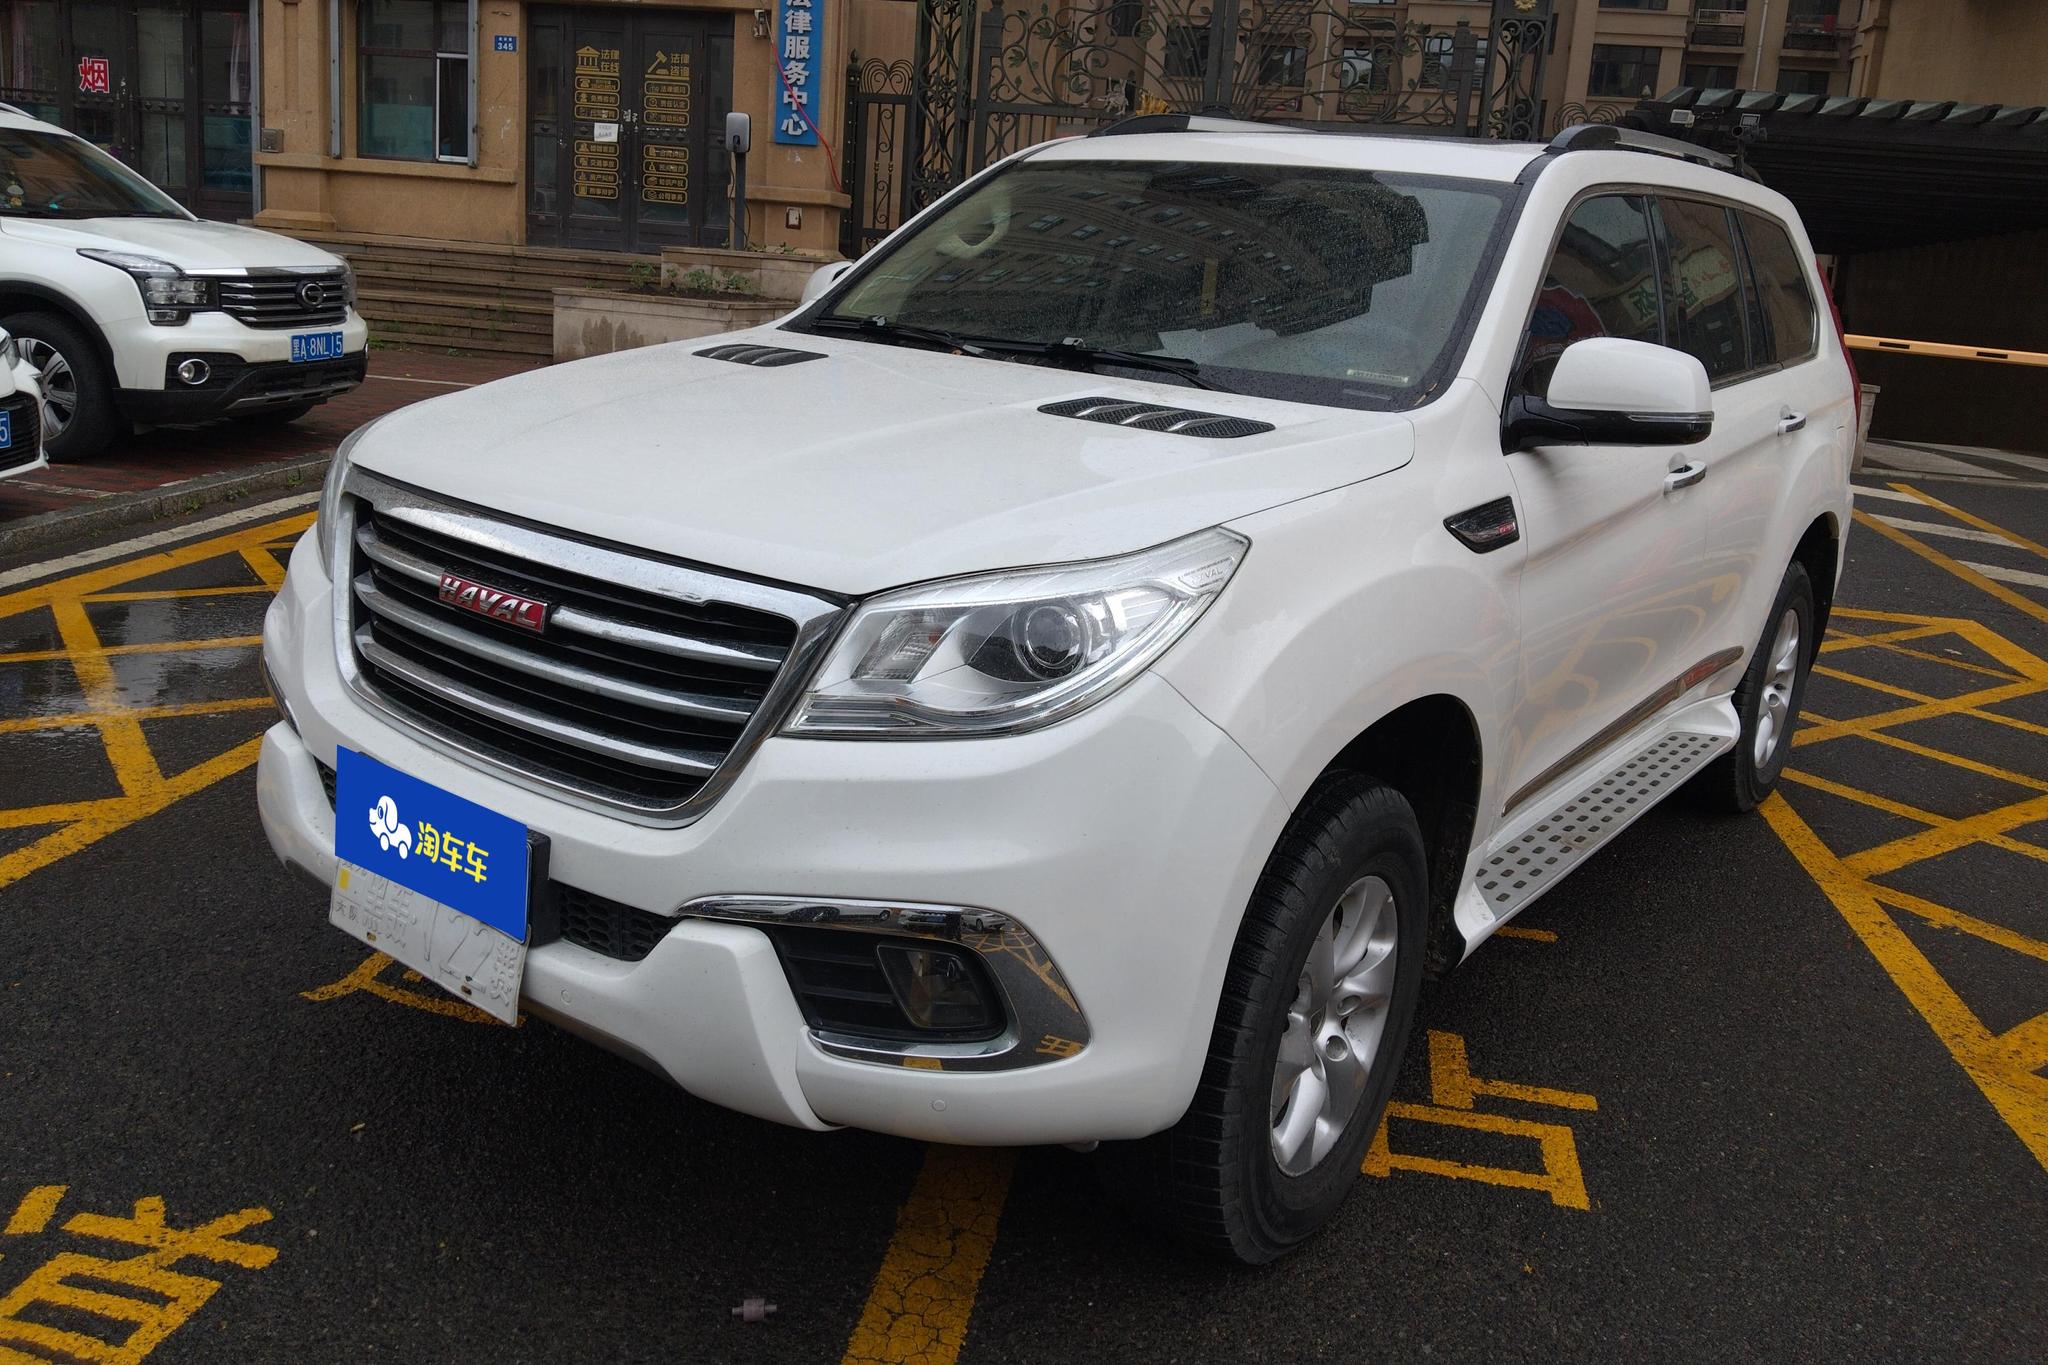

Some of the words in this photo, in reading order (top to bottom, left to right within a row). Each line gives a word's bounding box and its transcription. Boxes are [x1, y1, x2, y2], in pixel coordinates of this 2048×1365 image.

[497, 42, 514, 51] 345
[78, 57, 110, 93] 烟
[440, 577, 538, 627] HAVAL
